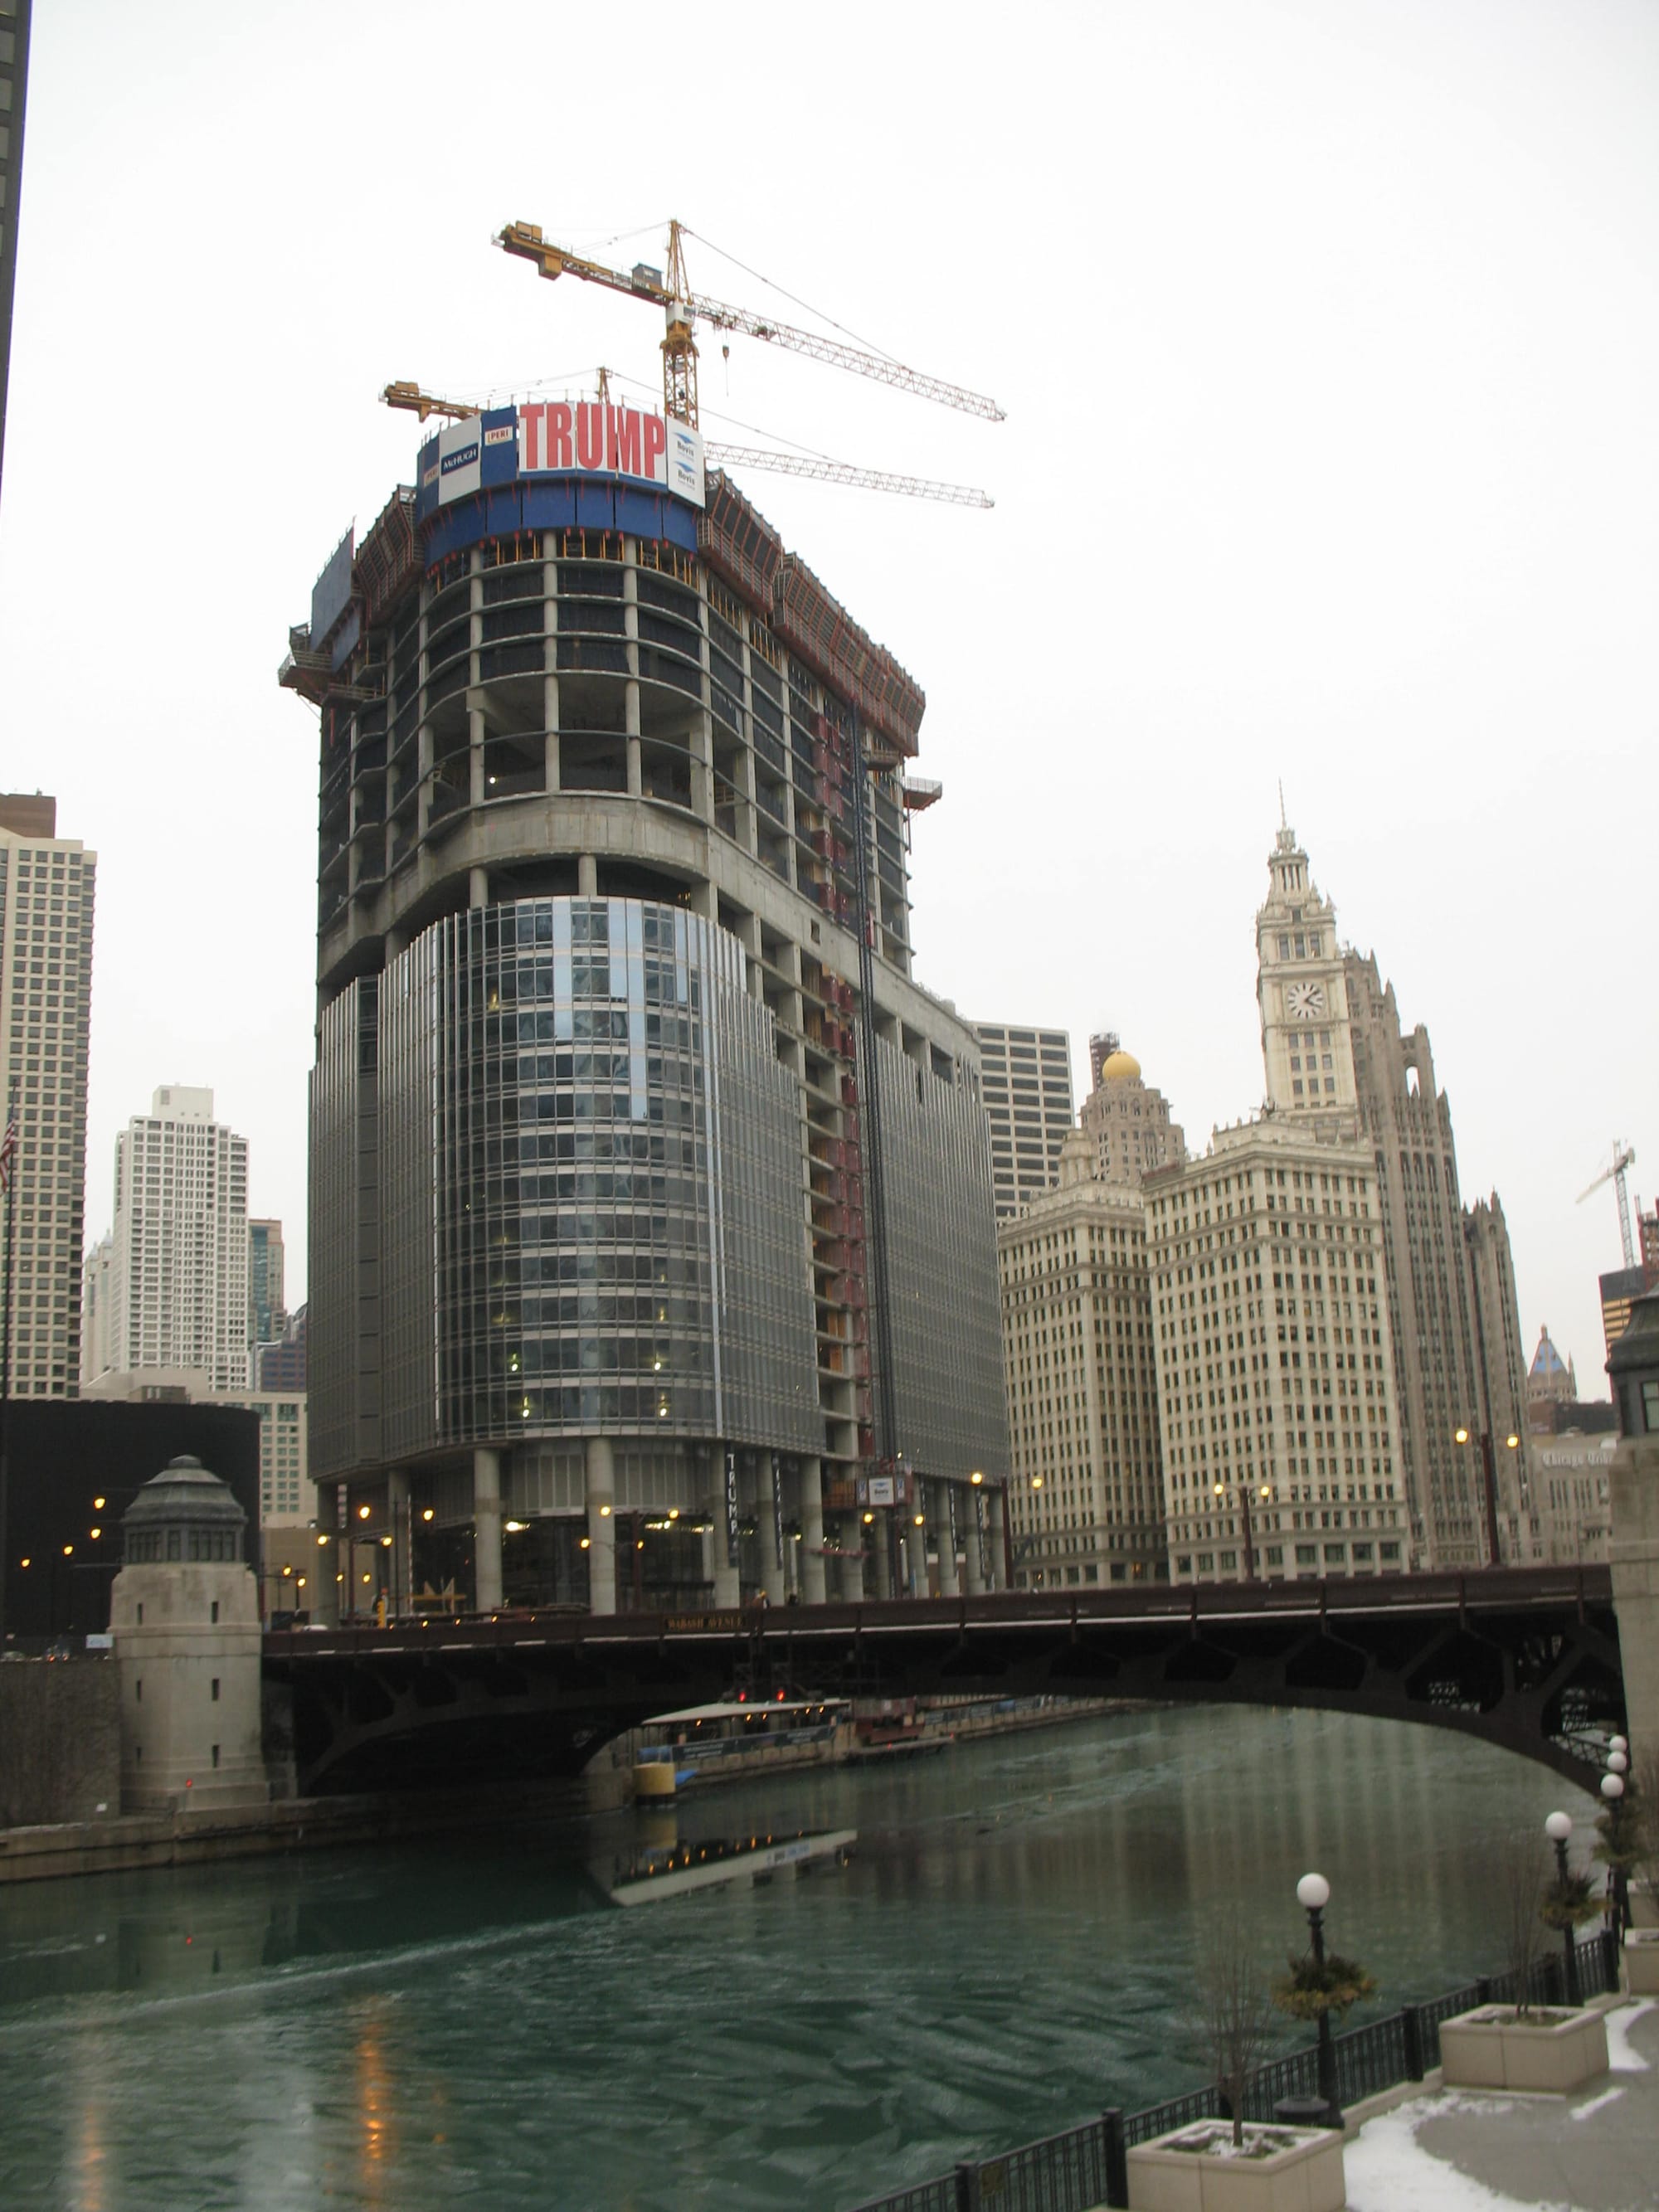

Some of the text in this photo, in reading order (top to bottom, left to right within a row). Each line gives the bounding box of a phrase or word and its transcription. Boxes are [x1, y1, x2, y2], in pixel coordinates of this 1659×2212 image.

[443, 449, 477, 469] McHUGH
[490, 430, 508, 440] PERI
[520, 403, 665, 479] TRUMP
[727, 1453, 737, 1535] TRUMP
